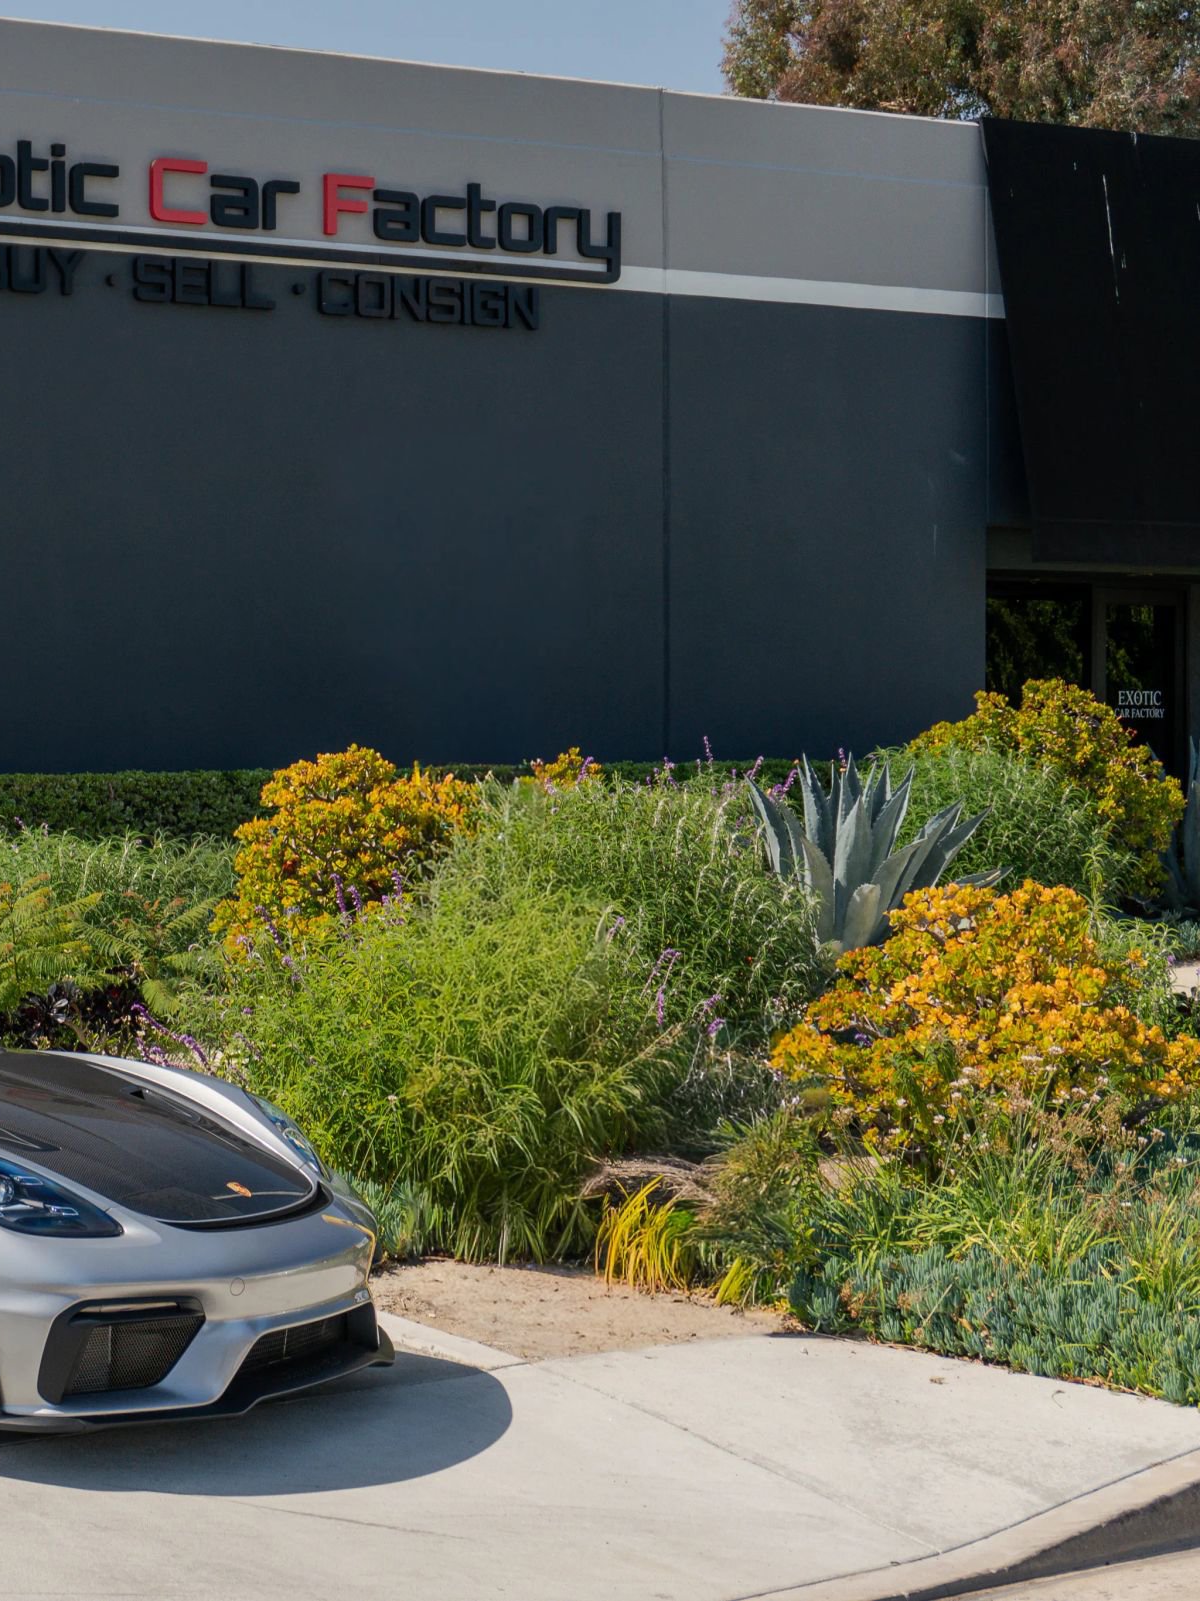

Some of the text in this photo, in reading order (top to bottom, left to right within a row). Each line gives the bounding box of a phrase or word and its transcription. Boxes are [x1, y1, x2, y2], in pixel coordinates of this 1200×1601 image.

[149, 158, 301, 231] Car
[322, 173, 621, 283] Factory
[132, 254, 276, 310] SELL
[316, 269, 540, 331] CONSIGN
[1118, 690, 1162, 706] EXOTIC
[1131, 708, 1165, 719] FACTORY
